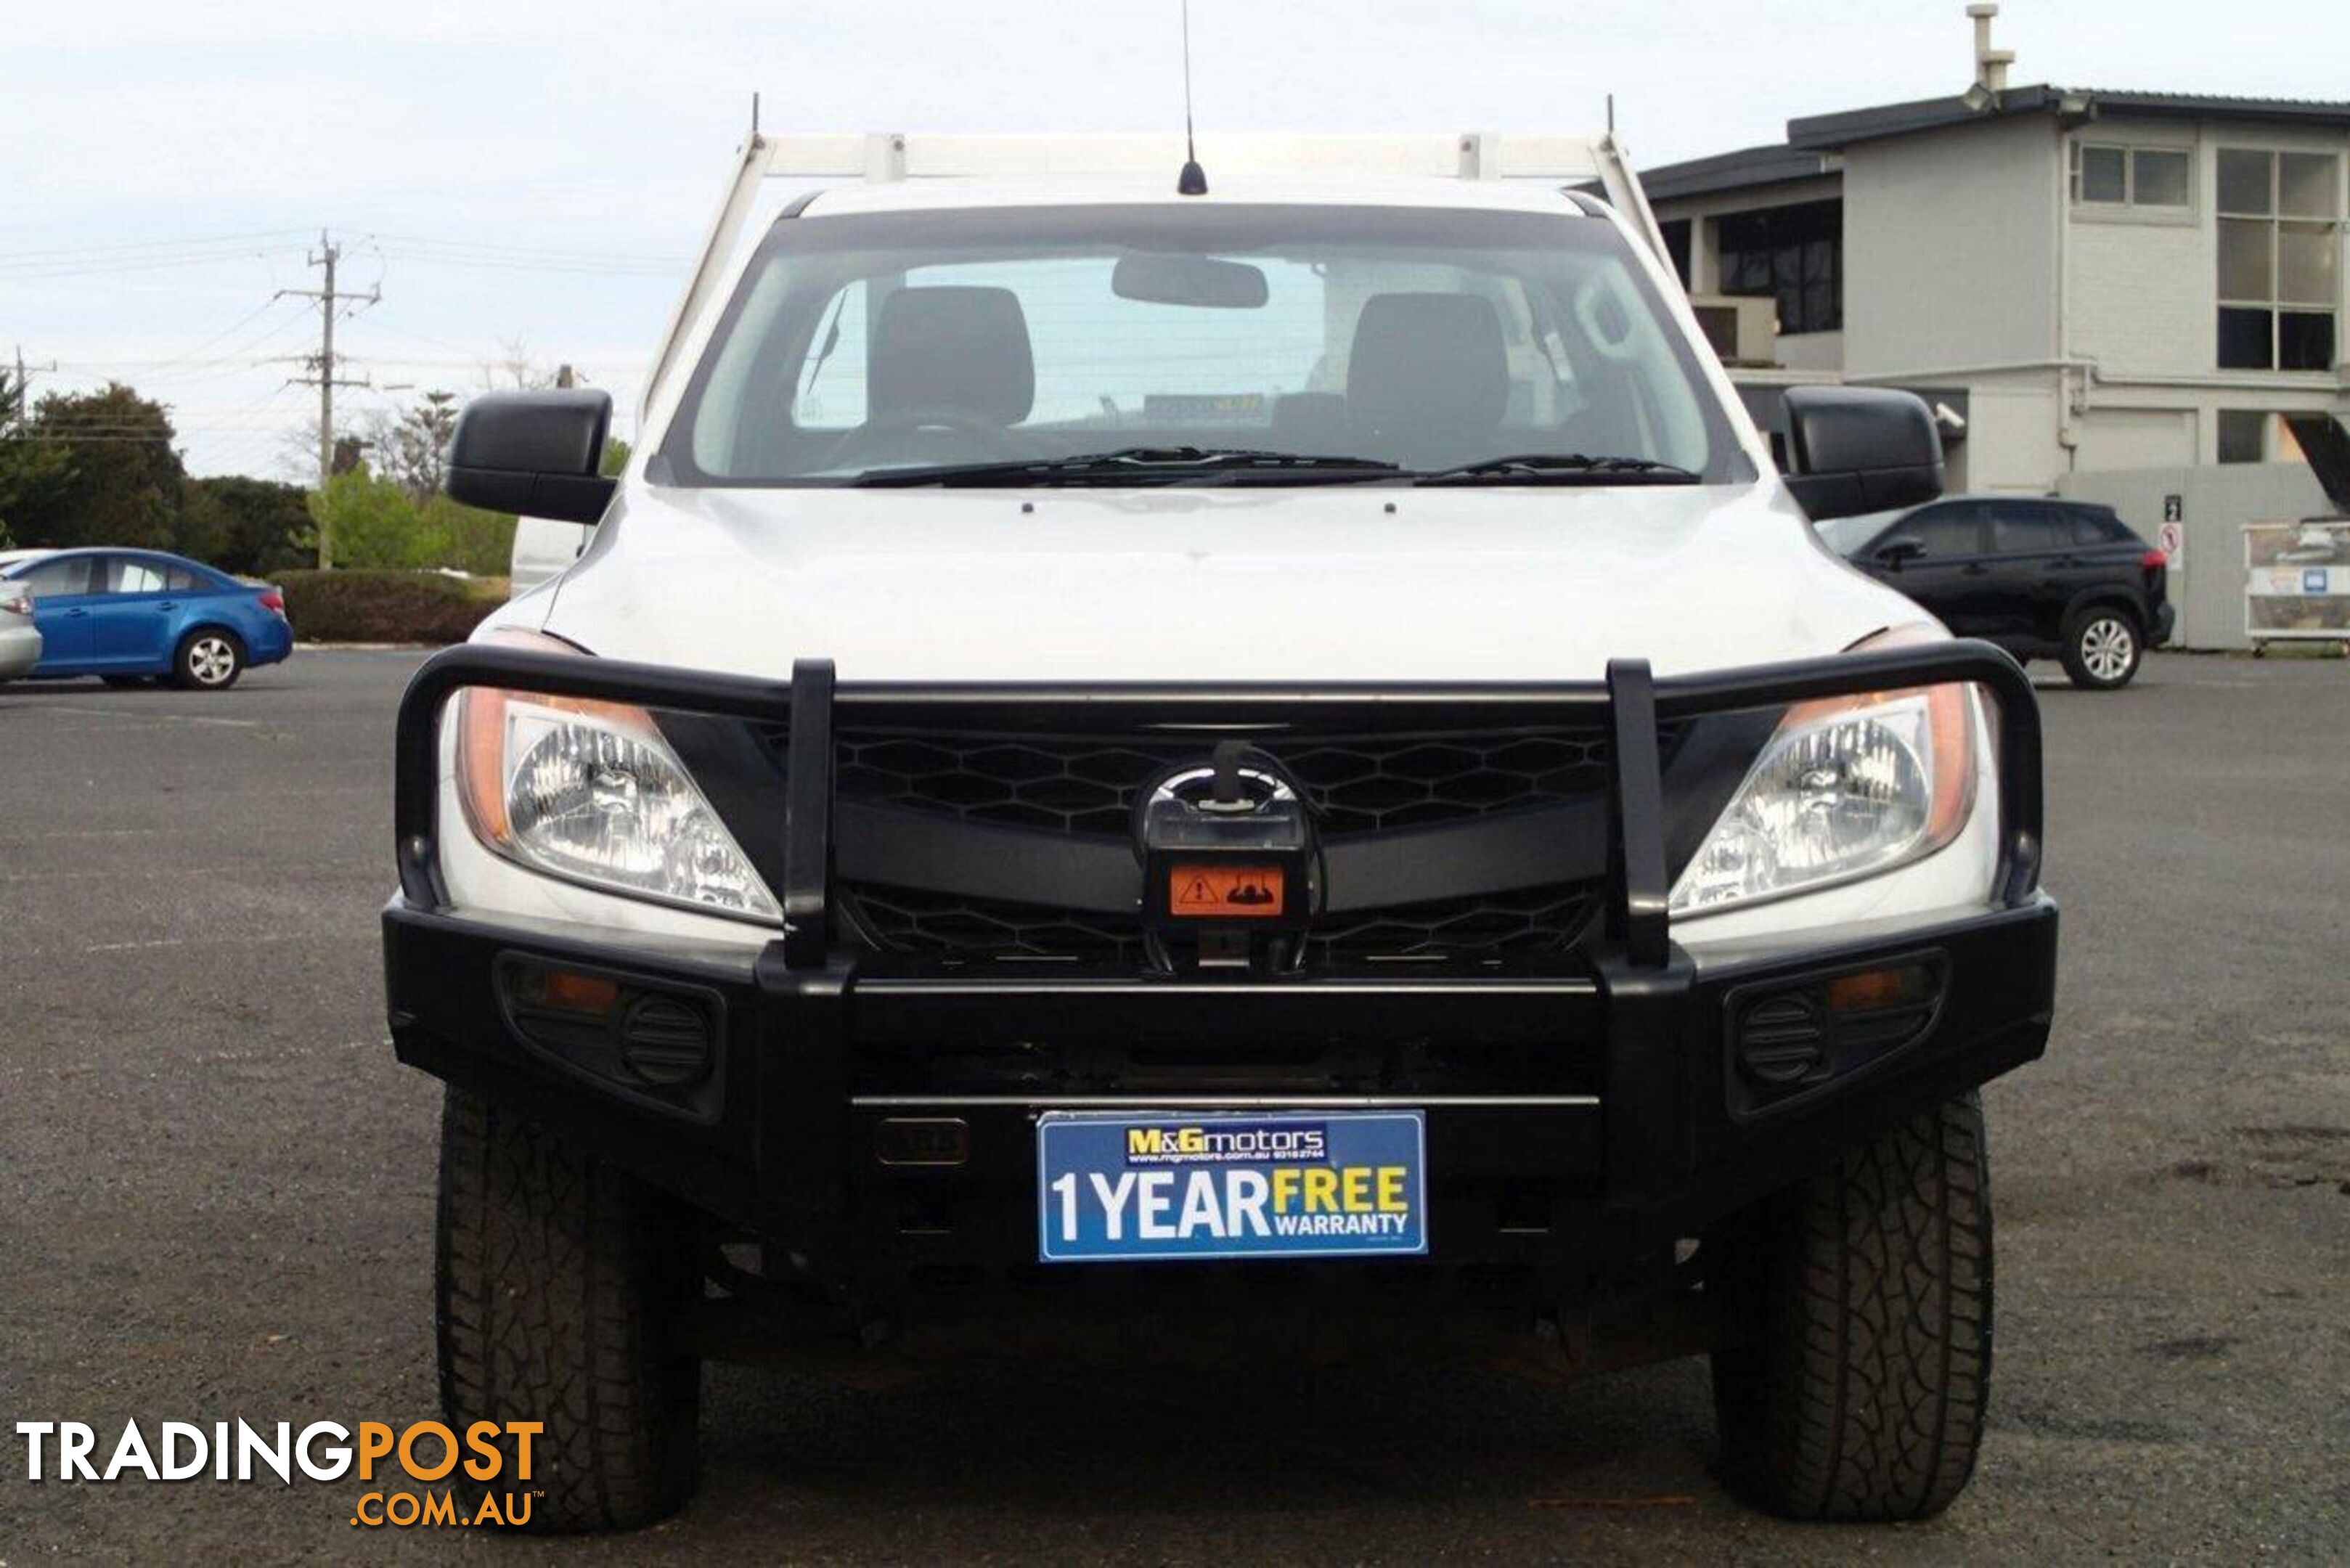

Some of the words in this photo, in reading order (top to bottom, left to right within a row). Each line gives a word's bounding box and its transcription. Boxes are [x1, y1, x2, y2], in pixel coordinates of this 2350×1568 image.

[1128, 1127, 1324, 1153] M&Gmotors
[1129, 1151, 1270, 1163] www.mgmotors.com.au
[1052, 1173, 1077, 1241] 1
[1090, 1170, 1273, 1238] YEAR
[1272, 1167, 1408, 1213] FREE
[1275, 1213, 1408, 1236] WARRANTY
